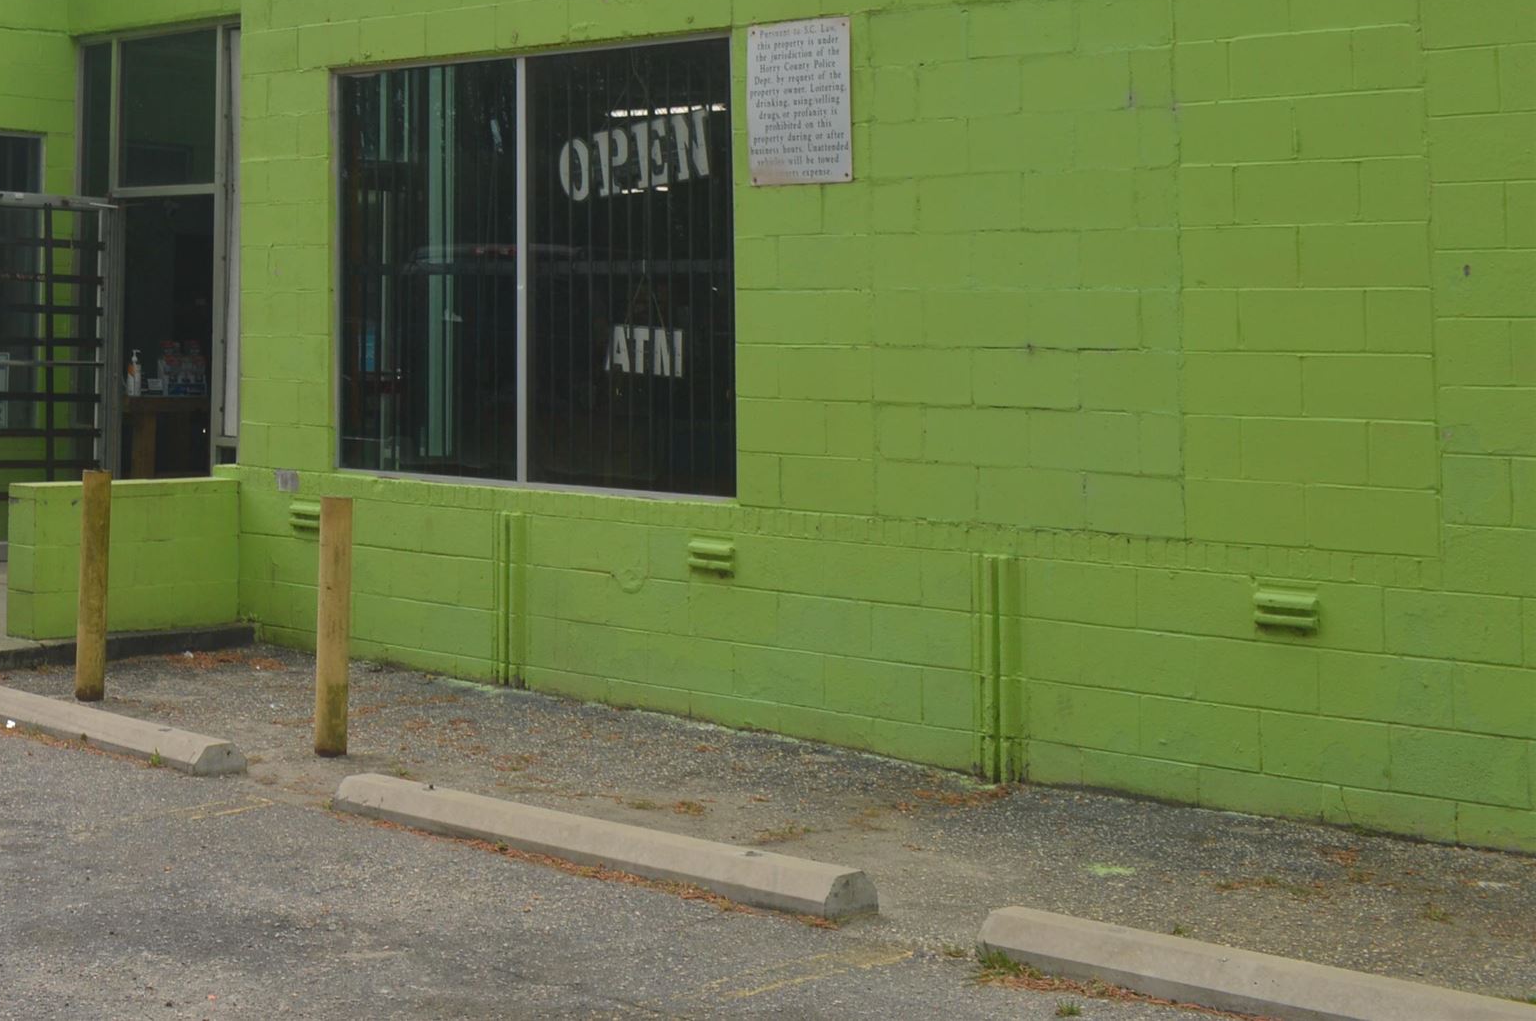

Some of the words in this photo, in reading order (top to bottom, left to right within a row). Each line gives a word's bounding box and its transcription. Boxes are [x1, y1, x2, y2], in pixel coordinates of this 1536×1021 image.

[757, 41, 770, 51] this
[774, 39, 804, 51] property
[817, 35, 839, 45] under
[756, 53, 767, 62] the
[770, 49, 812, 62] jurisdiction
[816, 48, 823, 56] of
[828, 46, 840, 55] the
[759, 64, 780, 74] Horry
[784, 61, 809, 72] County
[814, 58, 836, 69] Police
[776, 74, 784, 85] by
[788, 73, 814, 84] request
[817, 71, 825, 80] of
[830, 70, 842, 79] the
[750, 88, 779, 99] property
[793, 107, 827, 120] profanity
[831, 107, 838, 115] is
[765, 119, 801, 132] prohibited
[817, 118, 832, 128] this
[753, 134, 784, 146] property
[787, 132, 812, 143] during
[815, 132, 823, 140] or
[827, 130, 845, 140] after
[559, 108, 711, 202] OPEN
[750, 145, 779, 155] business
[807, 140, 849, 153] Unattended
[788, 155, 802, 165] will
[806, 154, 814, 165] be
[818, 153, 840, 164] towed
[605, 324, 683, 378] ATM
